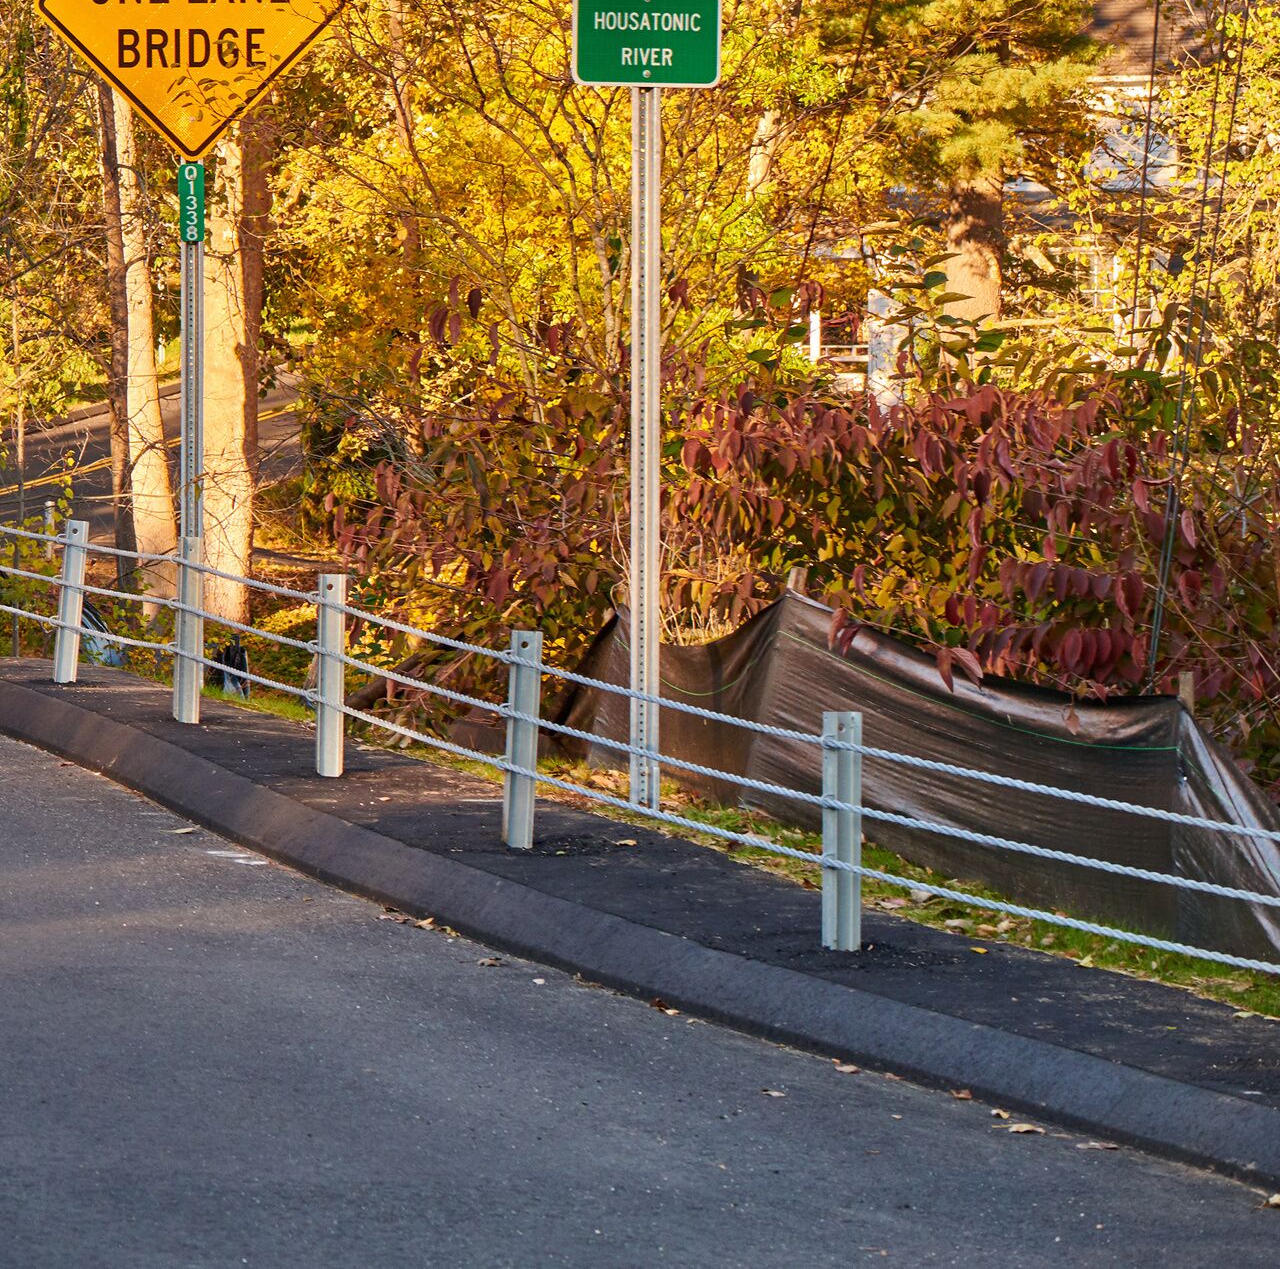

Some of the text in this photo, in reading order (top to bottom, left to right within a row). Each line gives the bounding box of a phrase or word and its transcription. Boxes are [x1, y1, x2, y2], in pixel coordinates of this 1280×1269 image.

[594, 12, 701, 32] HOUSATONIC
[117, 28, 267, 68] BRIDGE
[622, 47, 673, 66] RIVER
